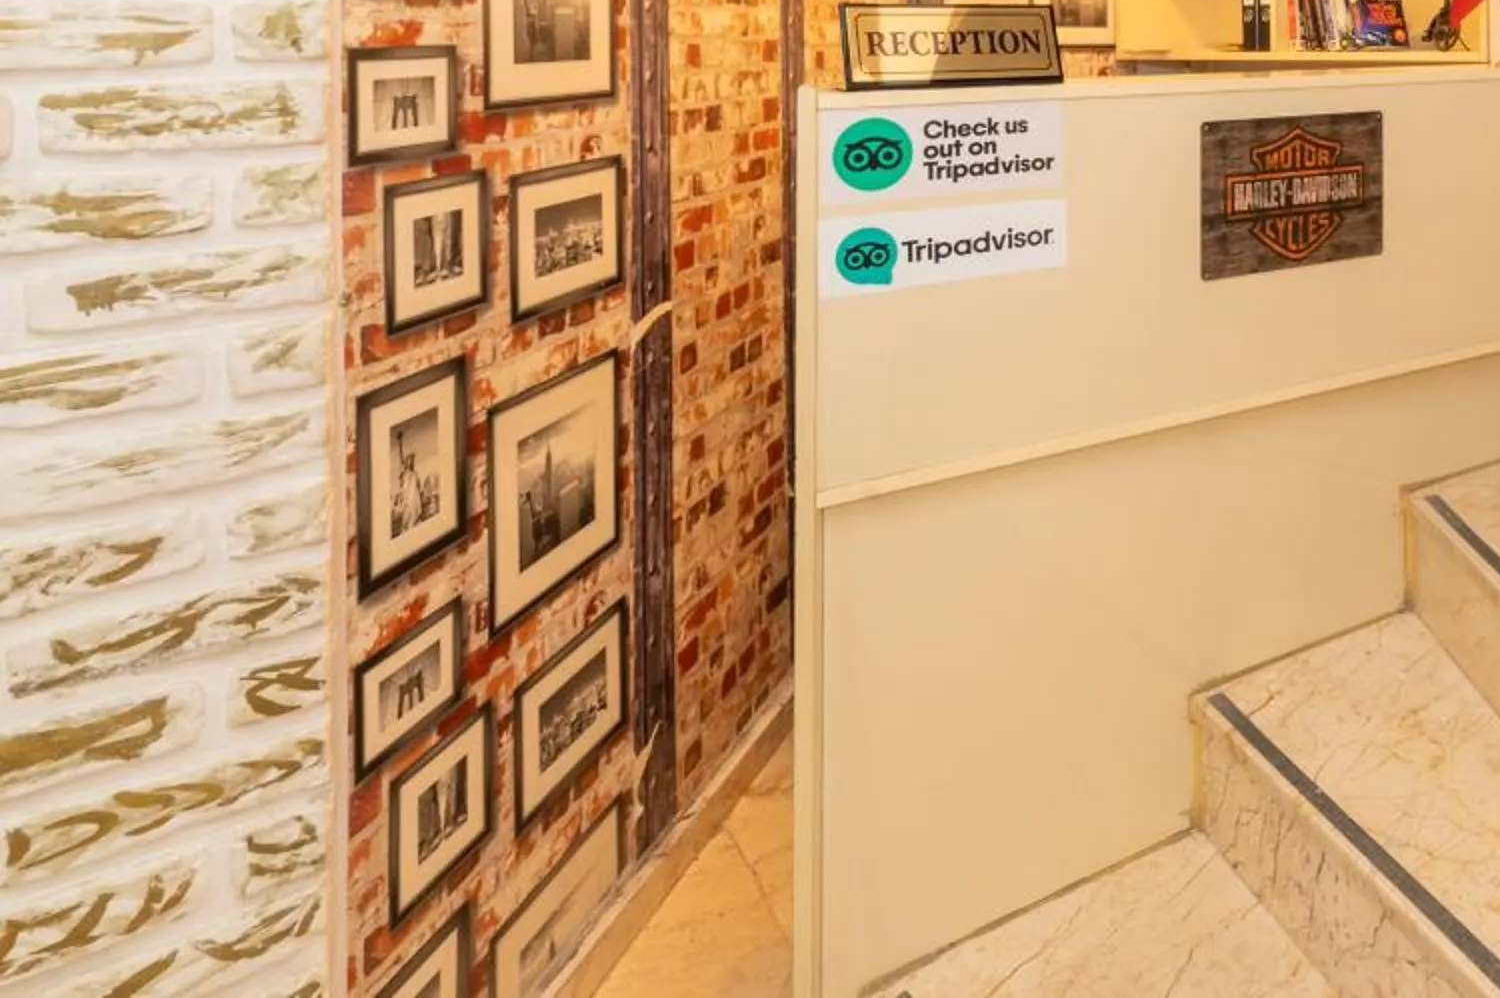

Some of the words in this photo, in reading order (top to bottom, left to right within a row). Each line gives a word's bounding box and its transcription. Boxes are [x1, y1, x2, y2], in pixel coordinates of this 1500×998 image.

[865, 29, 1042, 57] RECEPTION
[923, 118, 1000, 139] Check
[1005, 119, 1028, 134] us
[923, 140, 963, 159] out
[968, 139, 997, 156] on
[1264, 139, 1331, 170] MOTOR
[923, 155, 1055, 182] Tripadvisor
[1233, 172, 1358, 212] HARLEY-DAVIDSON
[902, 228, 1054, 264] Tripadvisor
[1264, 212, 1330, 251] CYCLES
